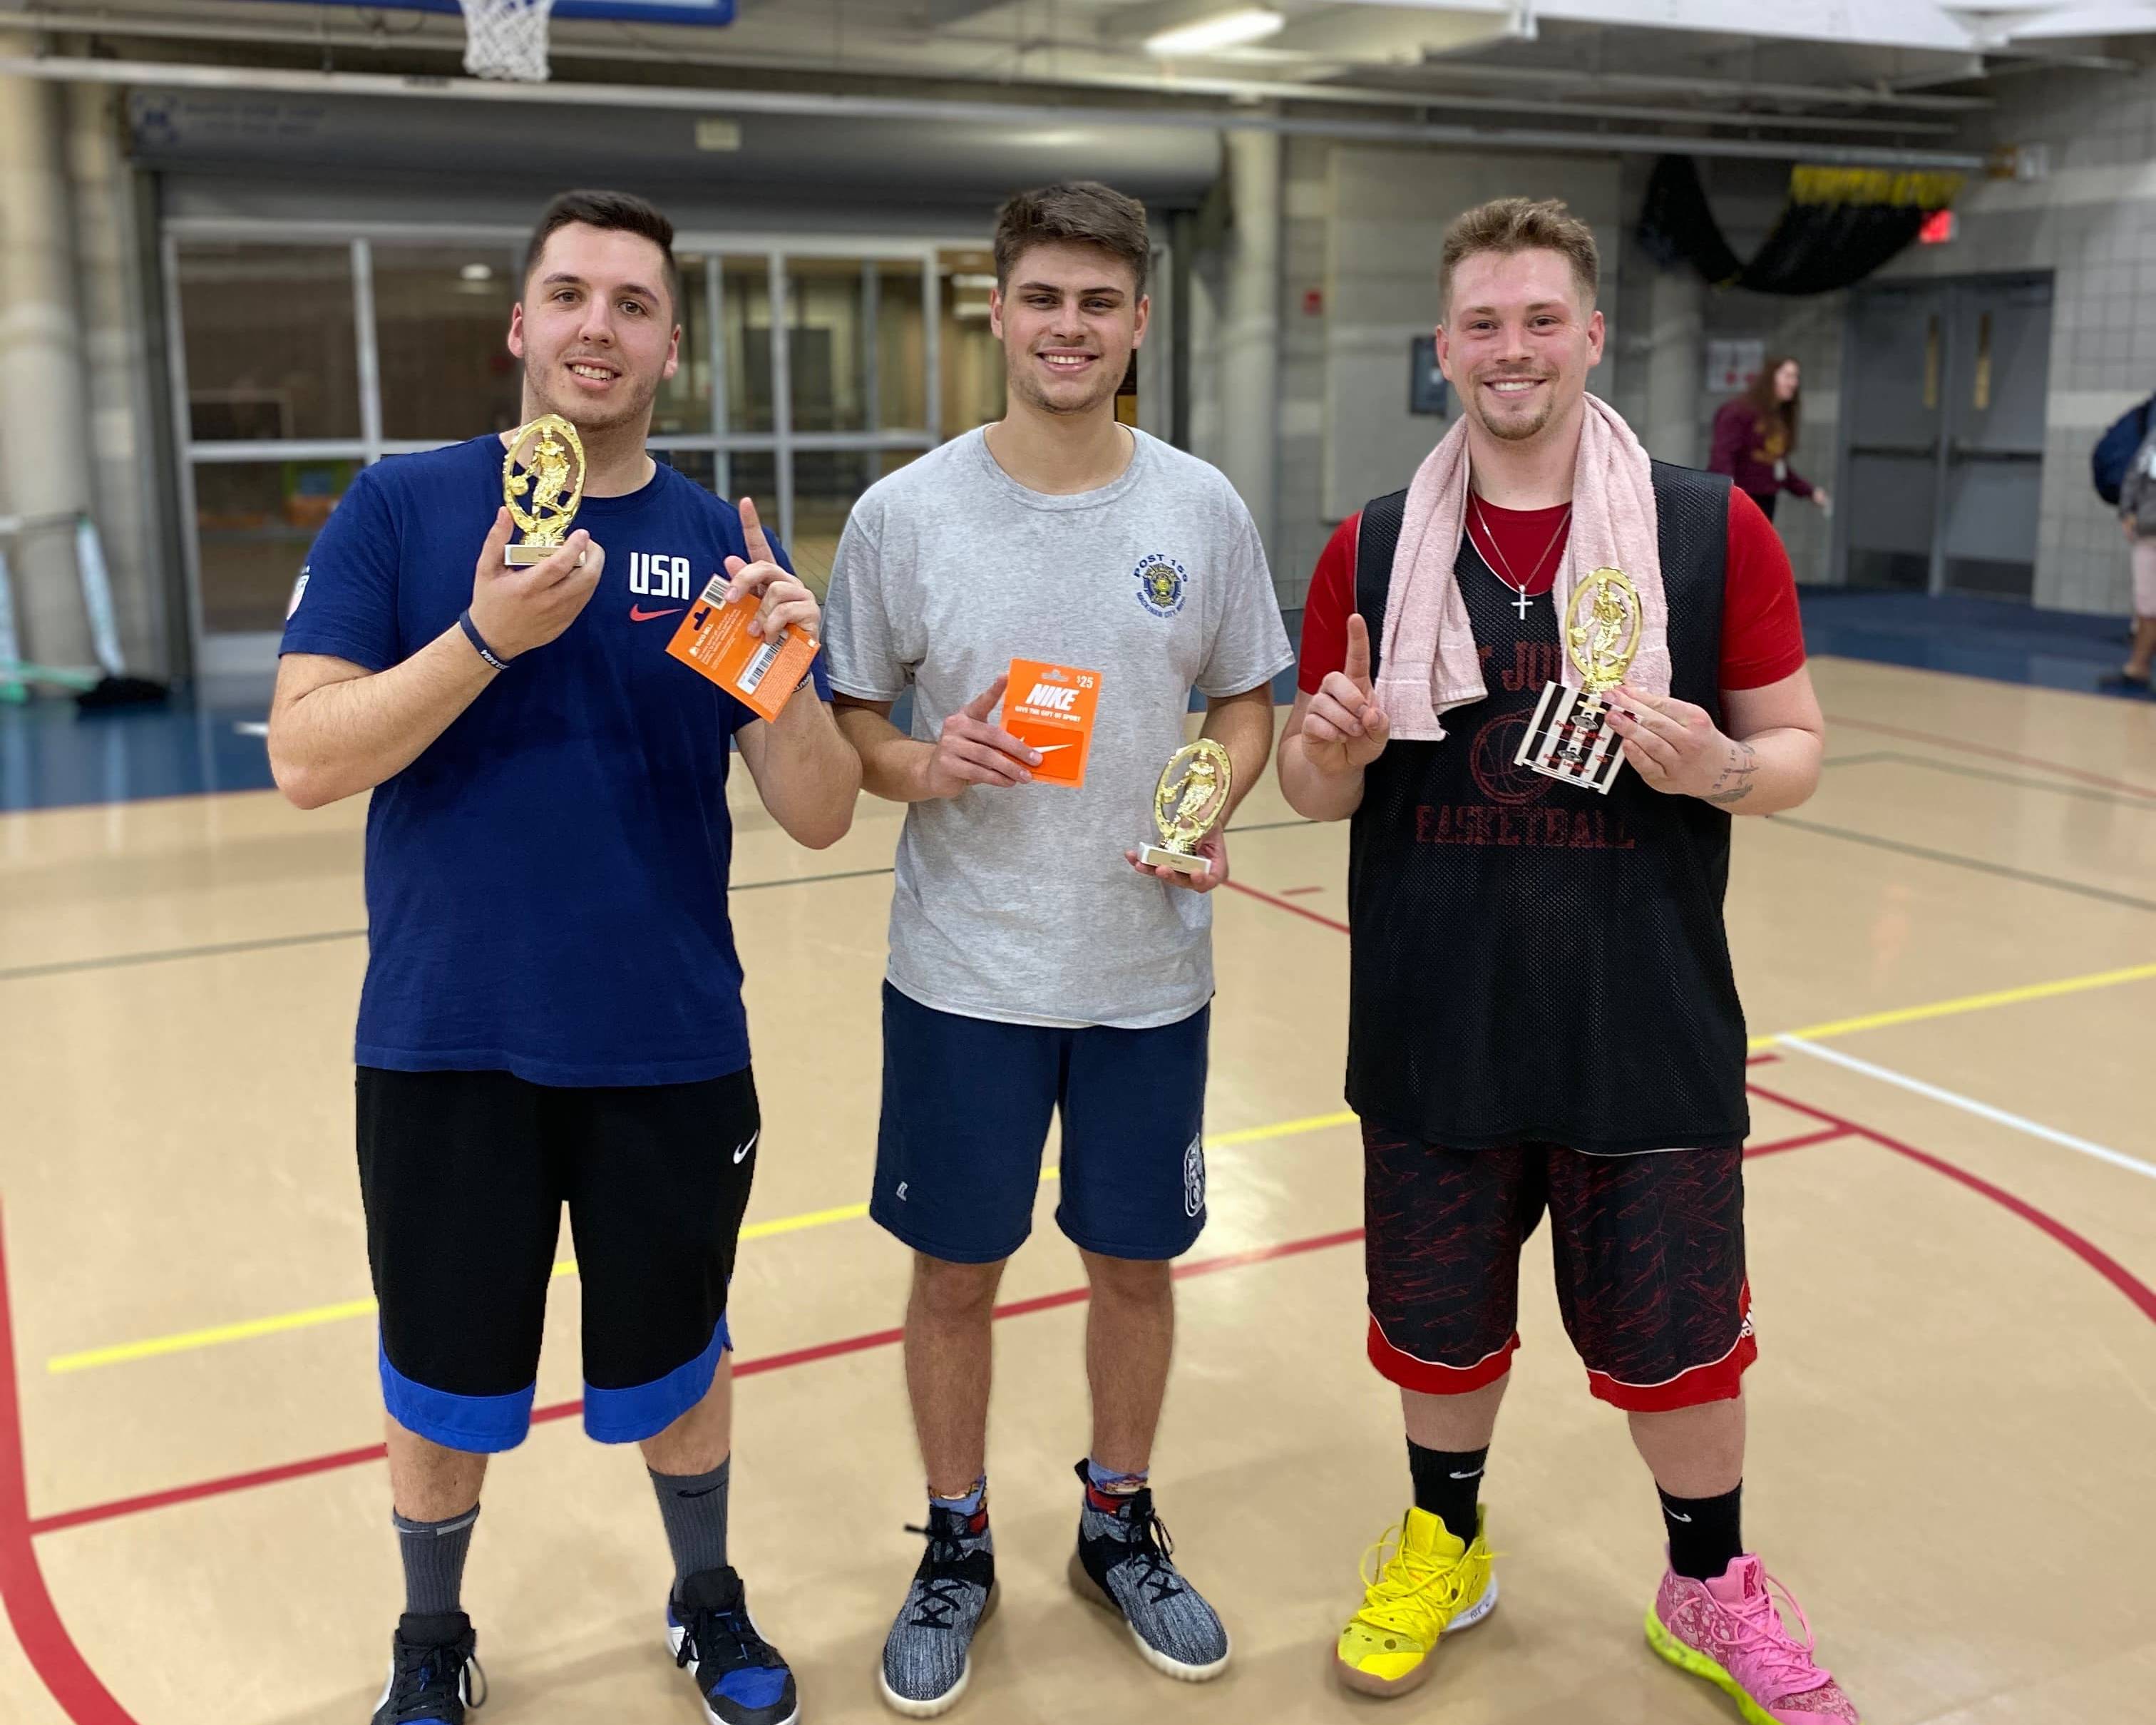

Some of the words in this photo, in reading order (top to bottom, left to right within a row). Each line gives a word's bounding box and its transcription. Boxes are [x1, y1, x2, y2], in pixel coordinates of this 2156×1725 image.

[630, 552, 689, 600] USA
[1134, 553, 1165, 578] POST
[1076, 675, 1094, 689] $25
[1025, 683, 1080, 711] NIKE
